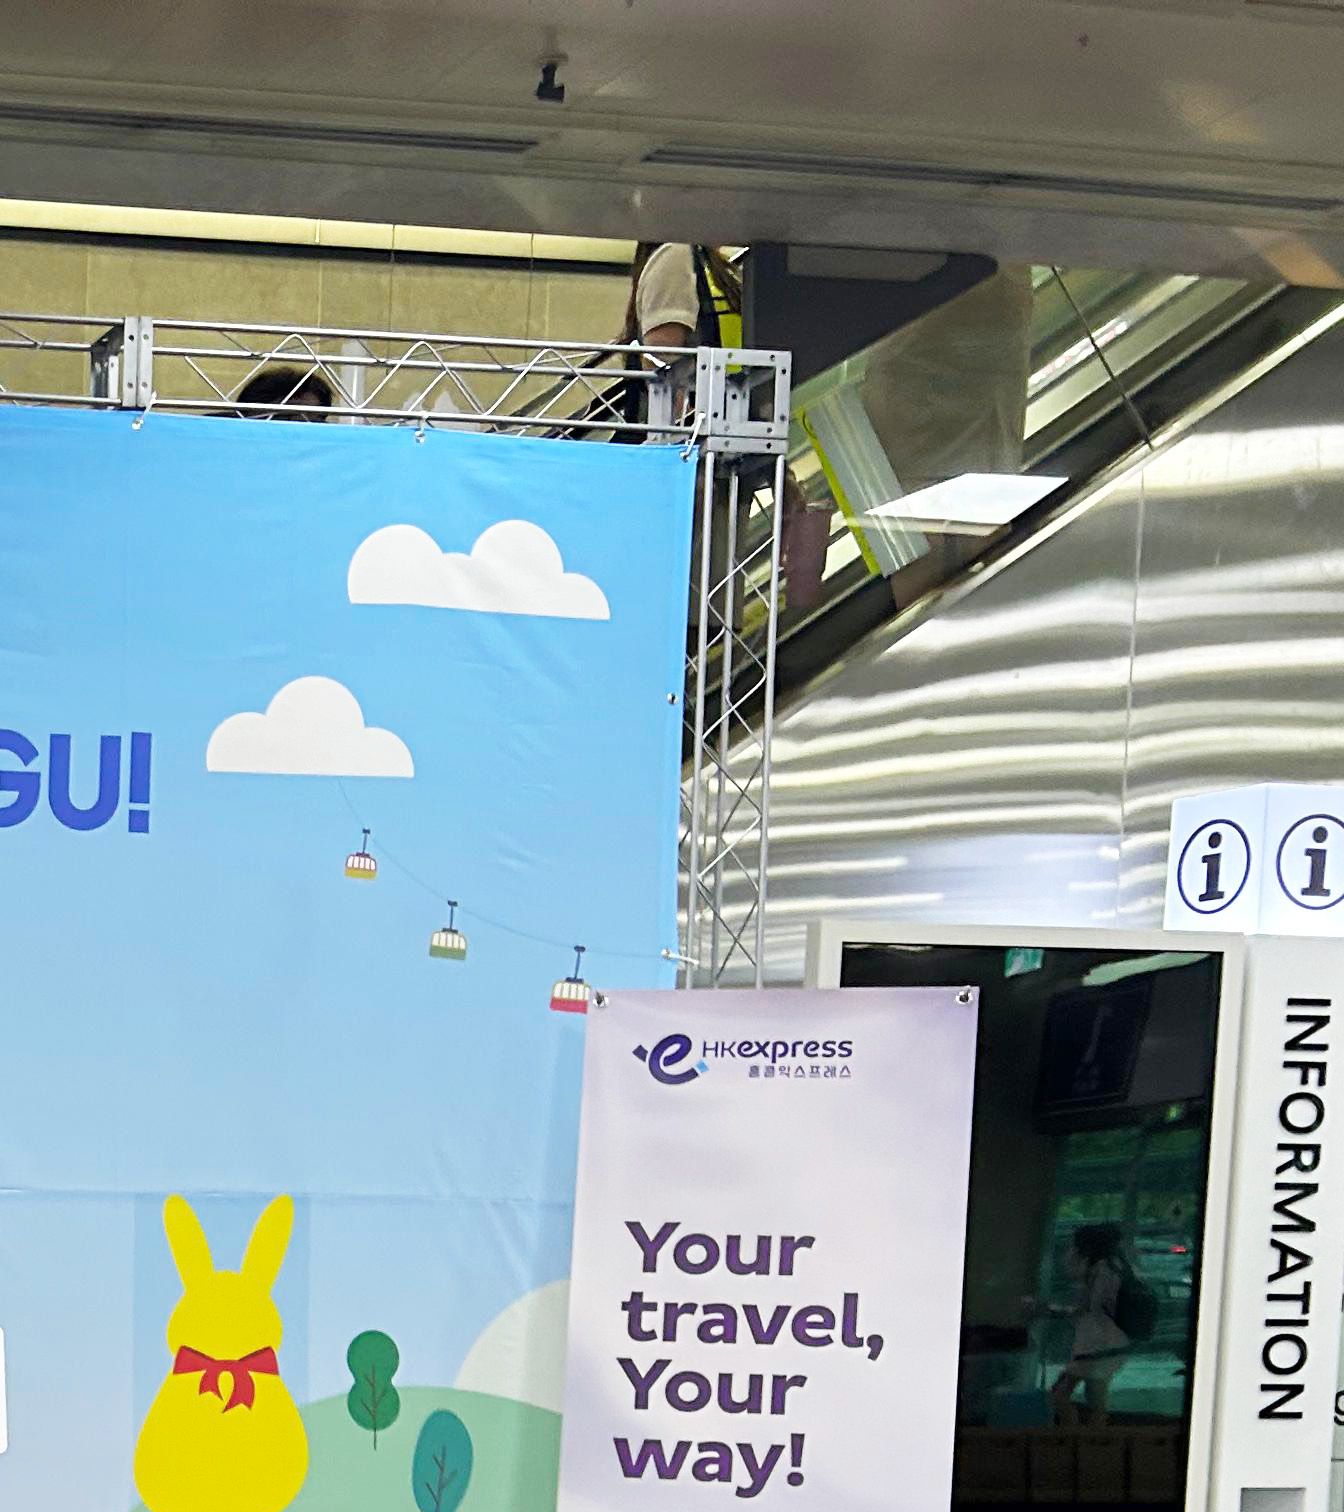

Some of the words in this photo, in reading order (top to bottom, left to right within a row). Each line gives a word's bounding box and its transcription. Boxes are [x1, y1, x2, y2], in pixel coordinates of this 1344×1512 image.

[702, 1039, 853, 1063] HKexpress
[1257, 996, 1332, 1421] INFORMATION
[624, 1220, 816, 1276] Your
[621, 1291, 885, 1361] travel,
[616, 1357, 808, 1416] Your
[612, 1433, 806, 1499] way!
